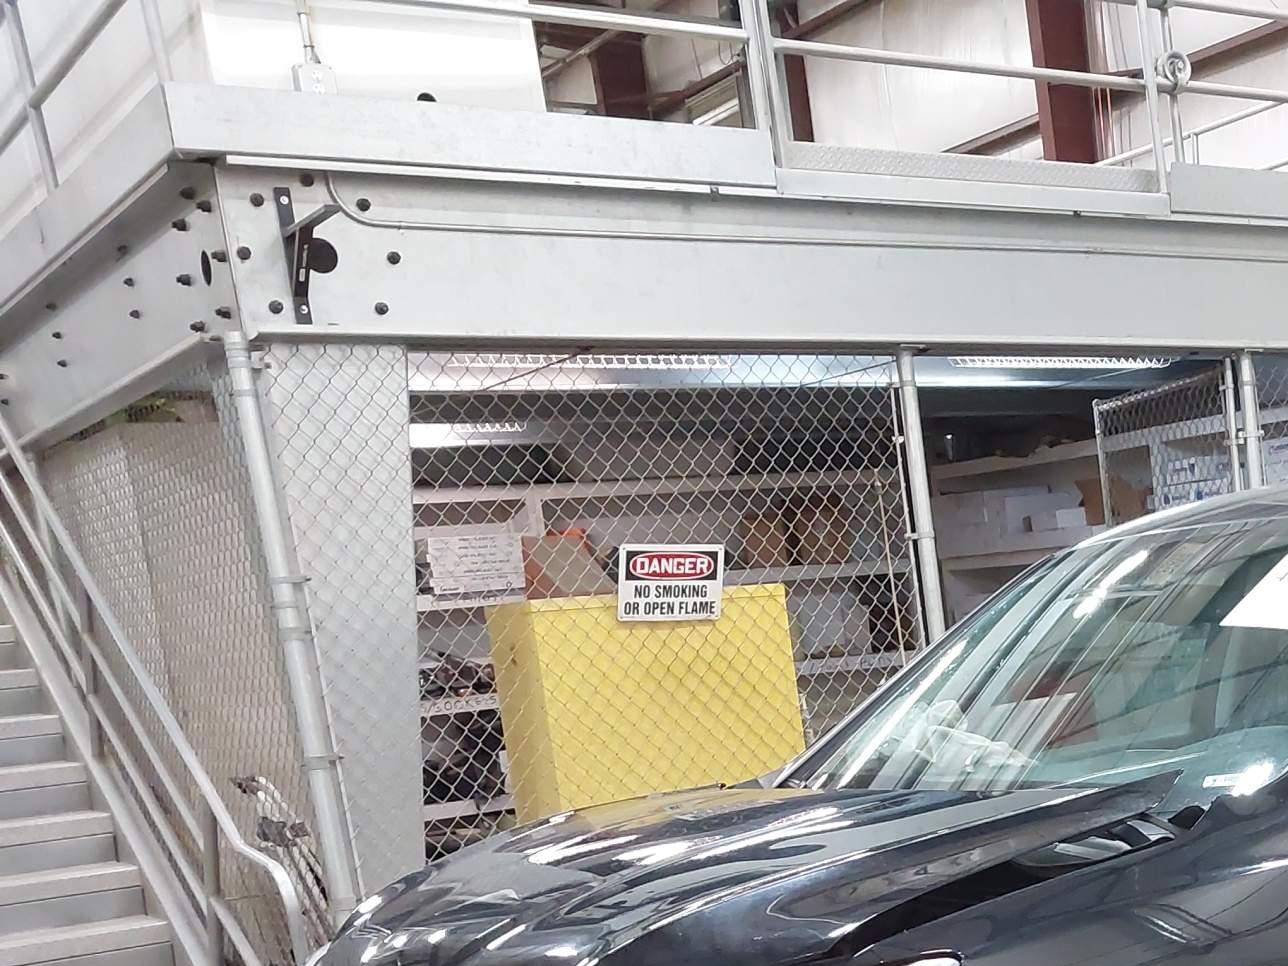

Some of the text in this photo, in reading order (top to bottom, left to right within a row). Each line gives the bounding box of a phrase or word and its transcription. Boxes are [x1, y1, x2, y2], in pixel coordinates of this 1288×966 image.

[636, 557, 708, 574] DANGER
[634, 584, 708, 599] NO SMOKING
[624, 600, 716, 615] OR OPEN FLAME
